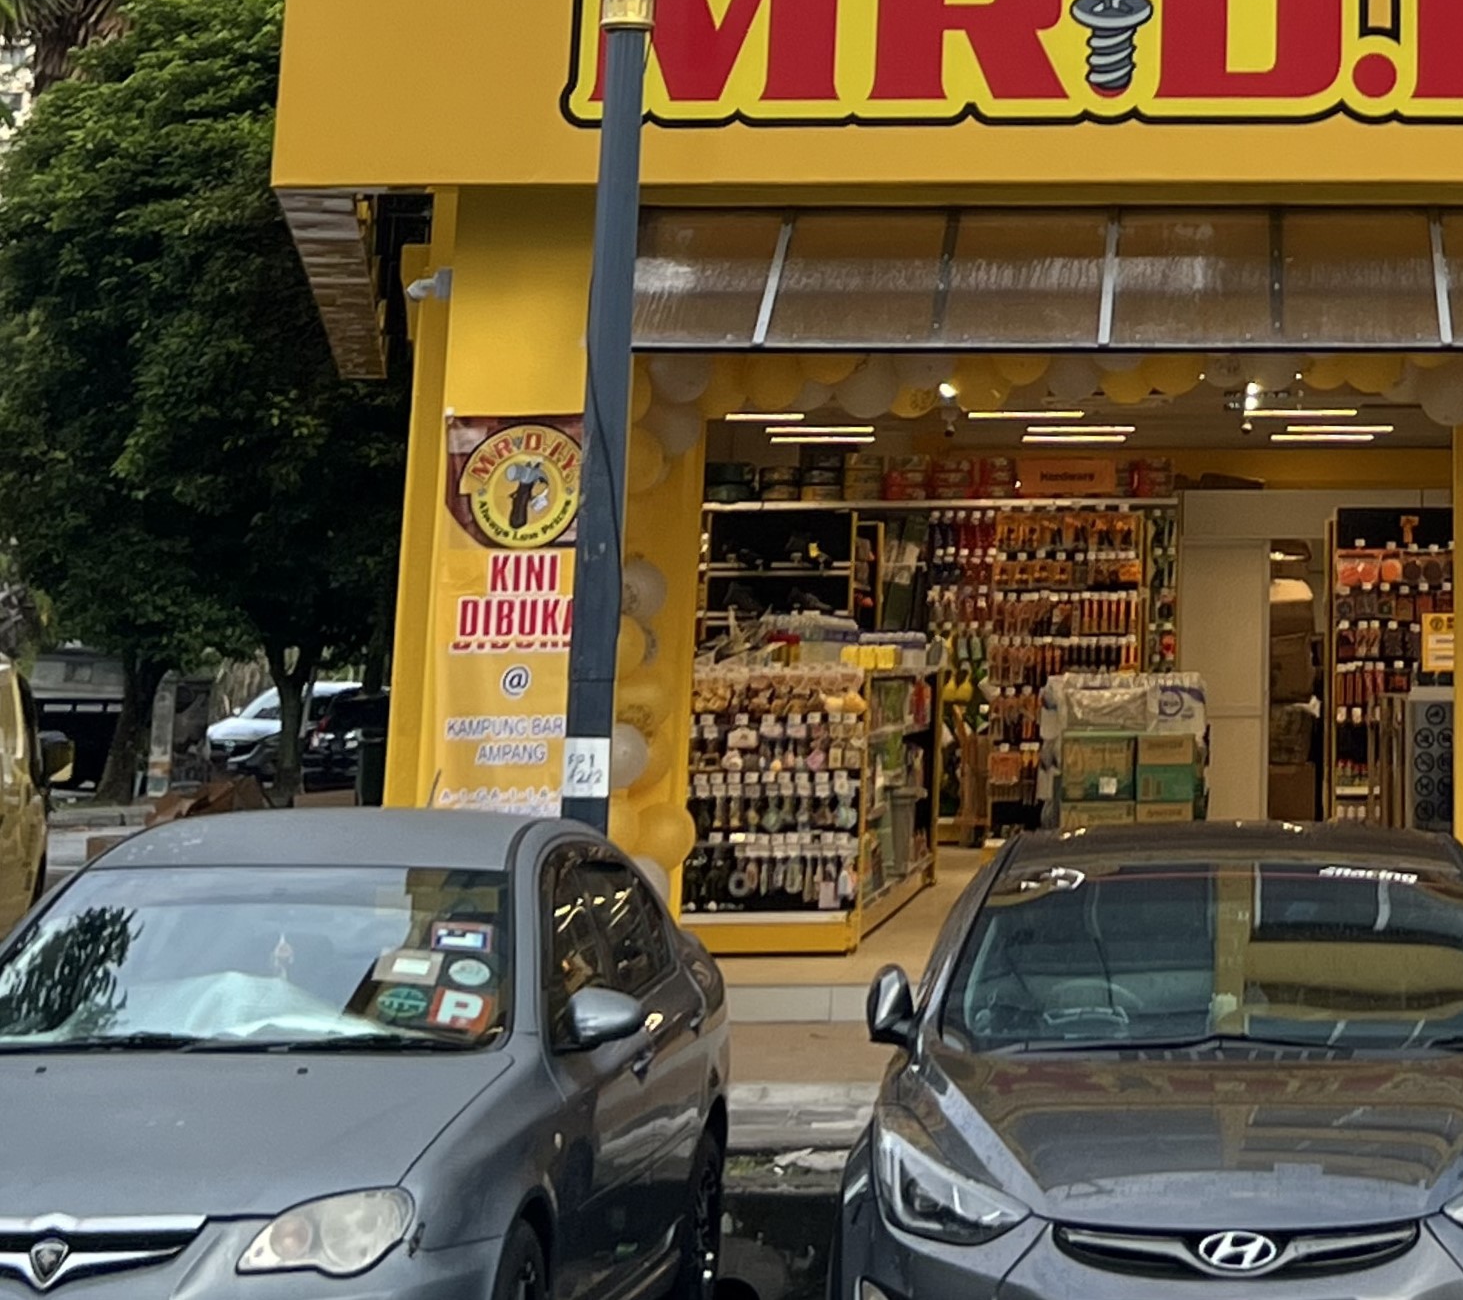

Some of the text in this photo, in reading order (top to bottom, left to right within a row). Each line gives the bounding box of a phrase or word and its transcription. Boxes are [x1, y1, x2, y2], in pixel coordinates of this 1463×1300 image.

[478, 499, 572, 541] Always Low Prices
[489, 554, 559, 592] KINI
[502, 665, 529, 696] @
[446, 715, 564, 737] KAMPUNG BAR
[476, 743, 547, 763] AMPANG
[436, 989, 485, 1024] P
